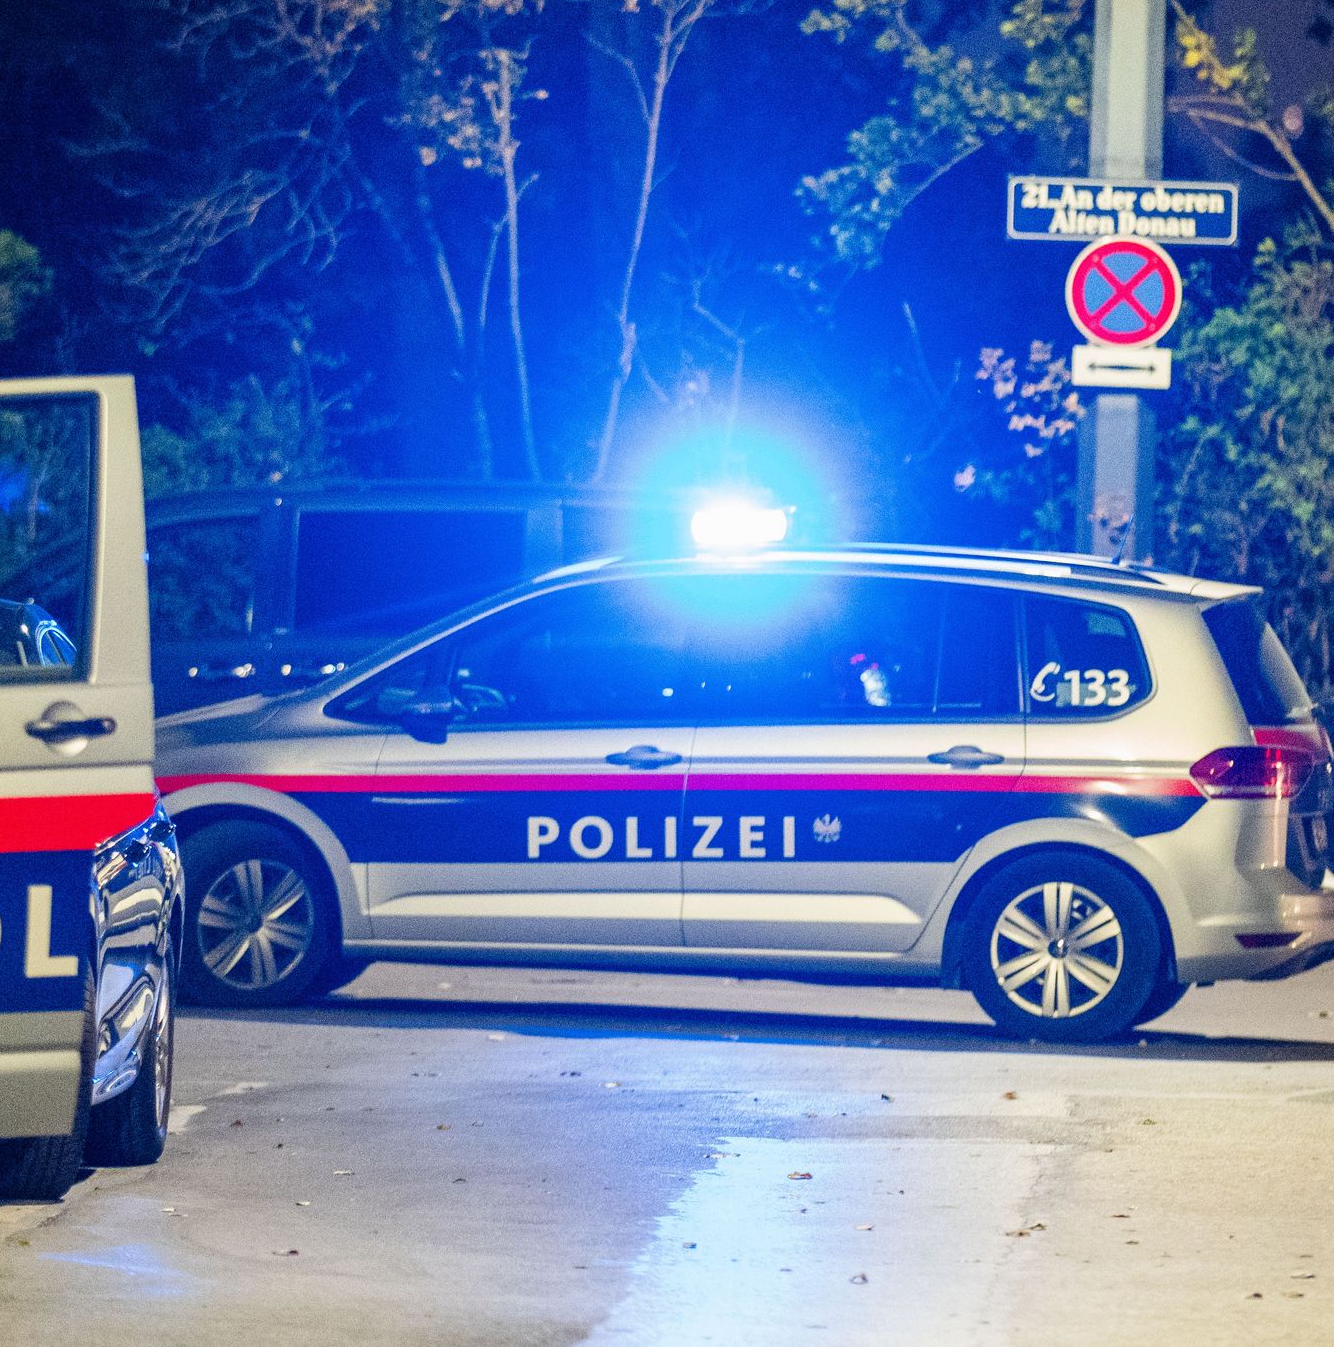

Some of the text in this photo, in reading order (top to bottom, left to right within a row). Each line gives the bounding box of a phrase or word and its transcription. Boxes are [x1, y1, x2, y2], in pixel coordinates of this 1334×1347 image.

[1096, 184, 1137, 213] der
[1140, 186, 1226, 214] oberen
[1049, 208, 1197, 238] Alten Donau
[1063, 668, 1131, 707] 133
[527, 815, 796, 859] POLIZEI
